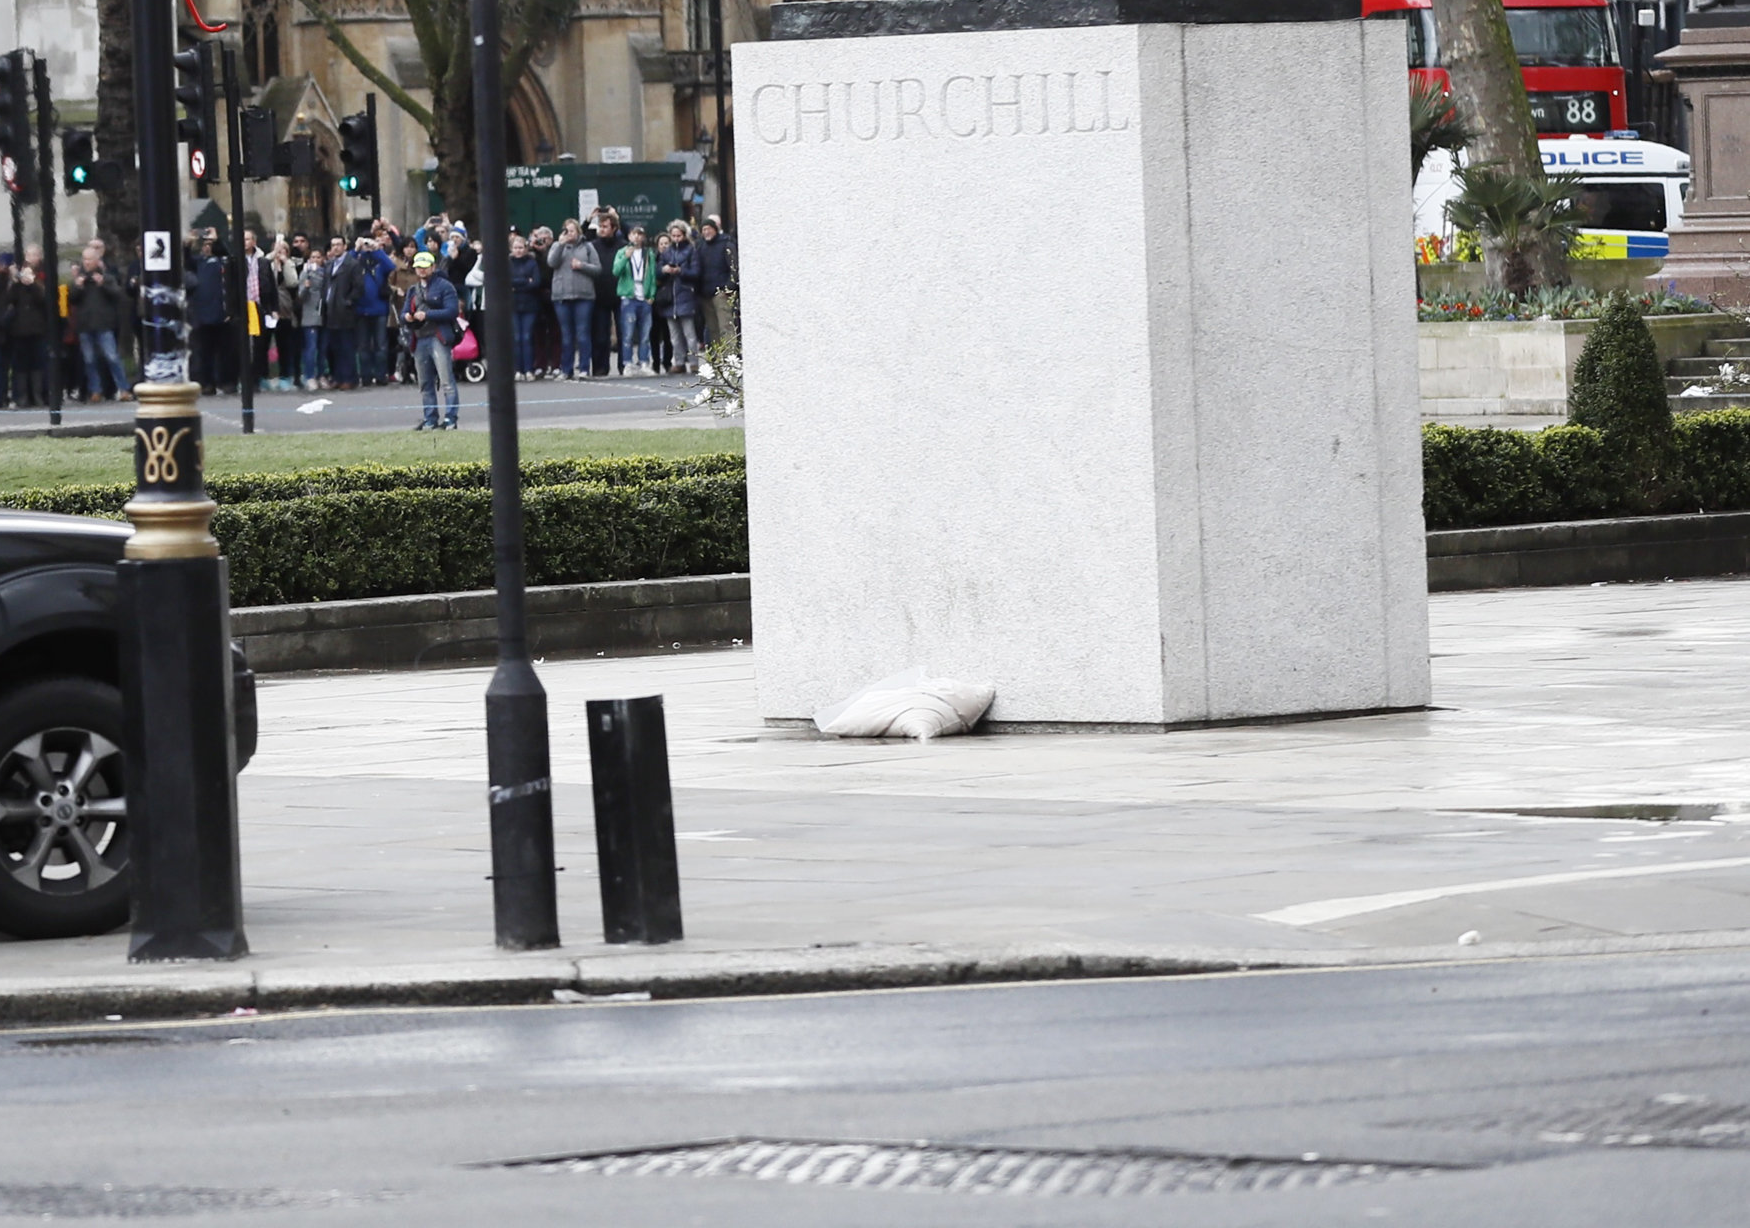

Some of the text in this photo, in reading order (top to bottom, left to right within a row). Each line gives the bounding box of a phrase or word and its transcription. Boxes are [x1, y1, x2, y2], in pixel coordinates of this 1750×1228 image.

[751, 70, 1130, 145] CHURCHILL
[1566, 99, 1596, 124] 88
[1540, 151, 1644, 165] OLICE
